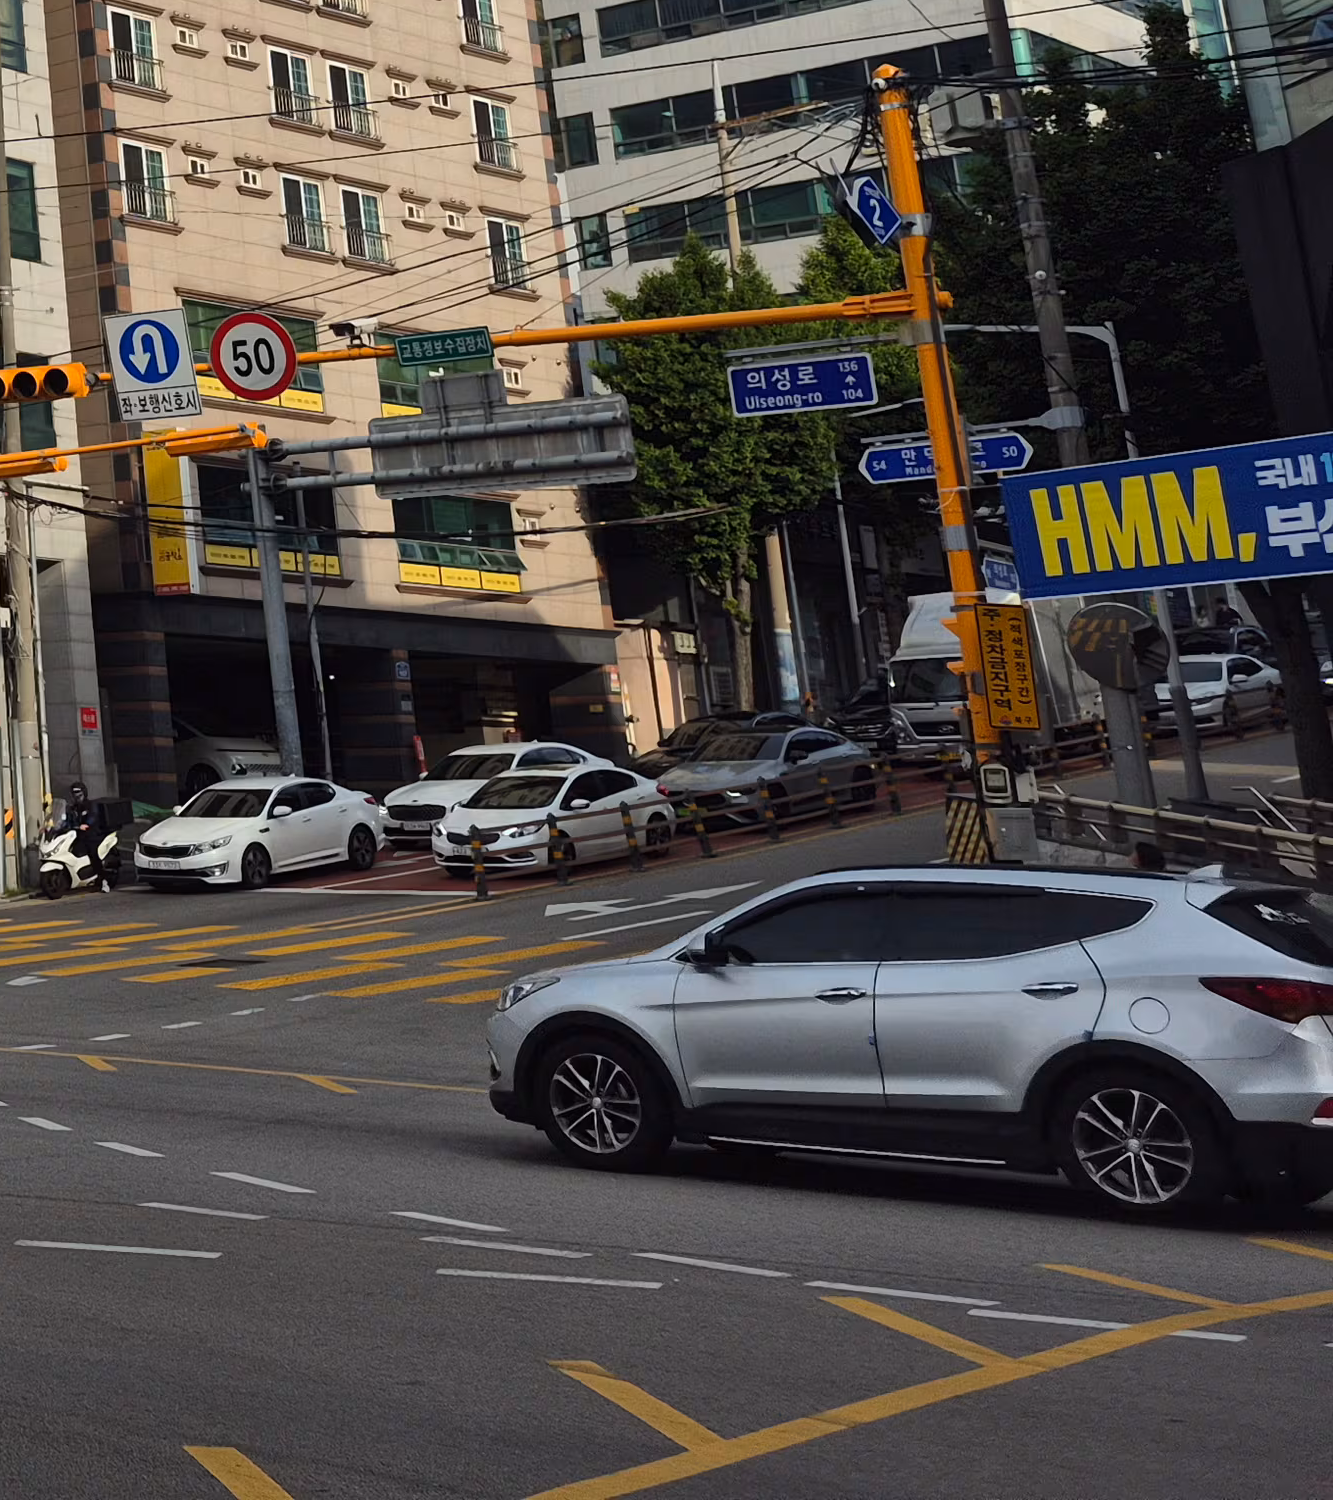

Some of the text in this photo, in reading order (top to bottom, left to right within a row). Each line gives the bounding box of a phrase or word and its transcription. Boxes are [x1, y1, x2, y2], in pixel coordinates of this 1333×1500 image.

[869, 198, 884, 227] 2
[232, 337, 276, 378] 50
[400, 333, 488, 358] 교통정보수집장치
[746, 365, 819, 391] 의성로
[837, 360, 859, 373] 136
[744, 391, 823, 410] Uiseong-ro
[841, 388, 864, 400] 104
[872, 441, 1018, 472] 54 만로 50
[1254, 453, 1319, 490] 국내
[1029, 465, 1257, 578] HMM,
[1264, 498, 1333, 558] 부
